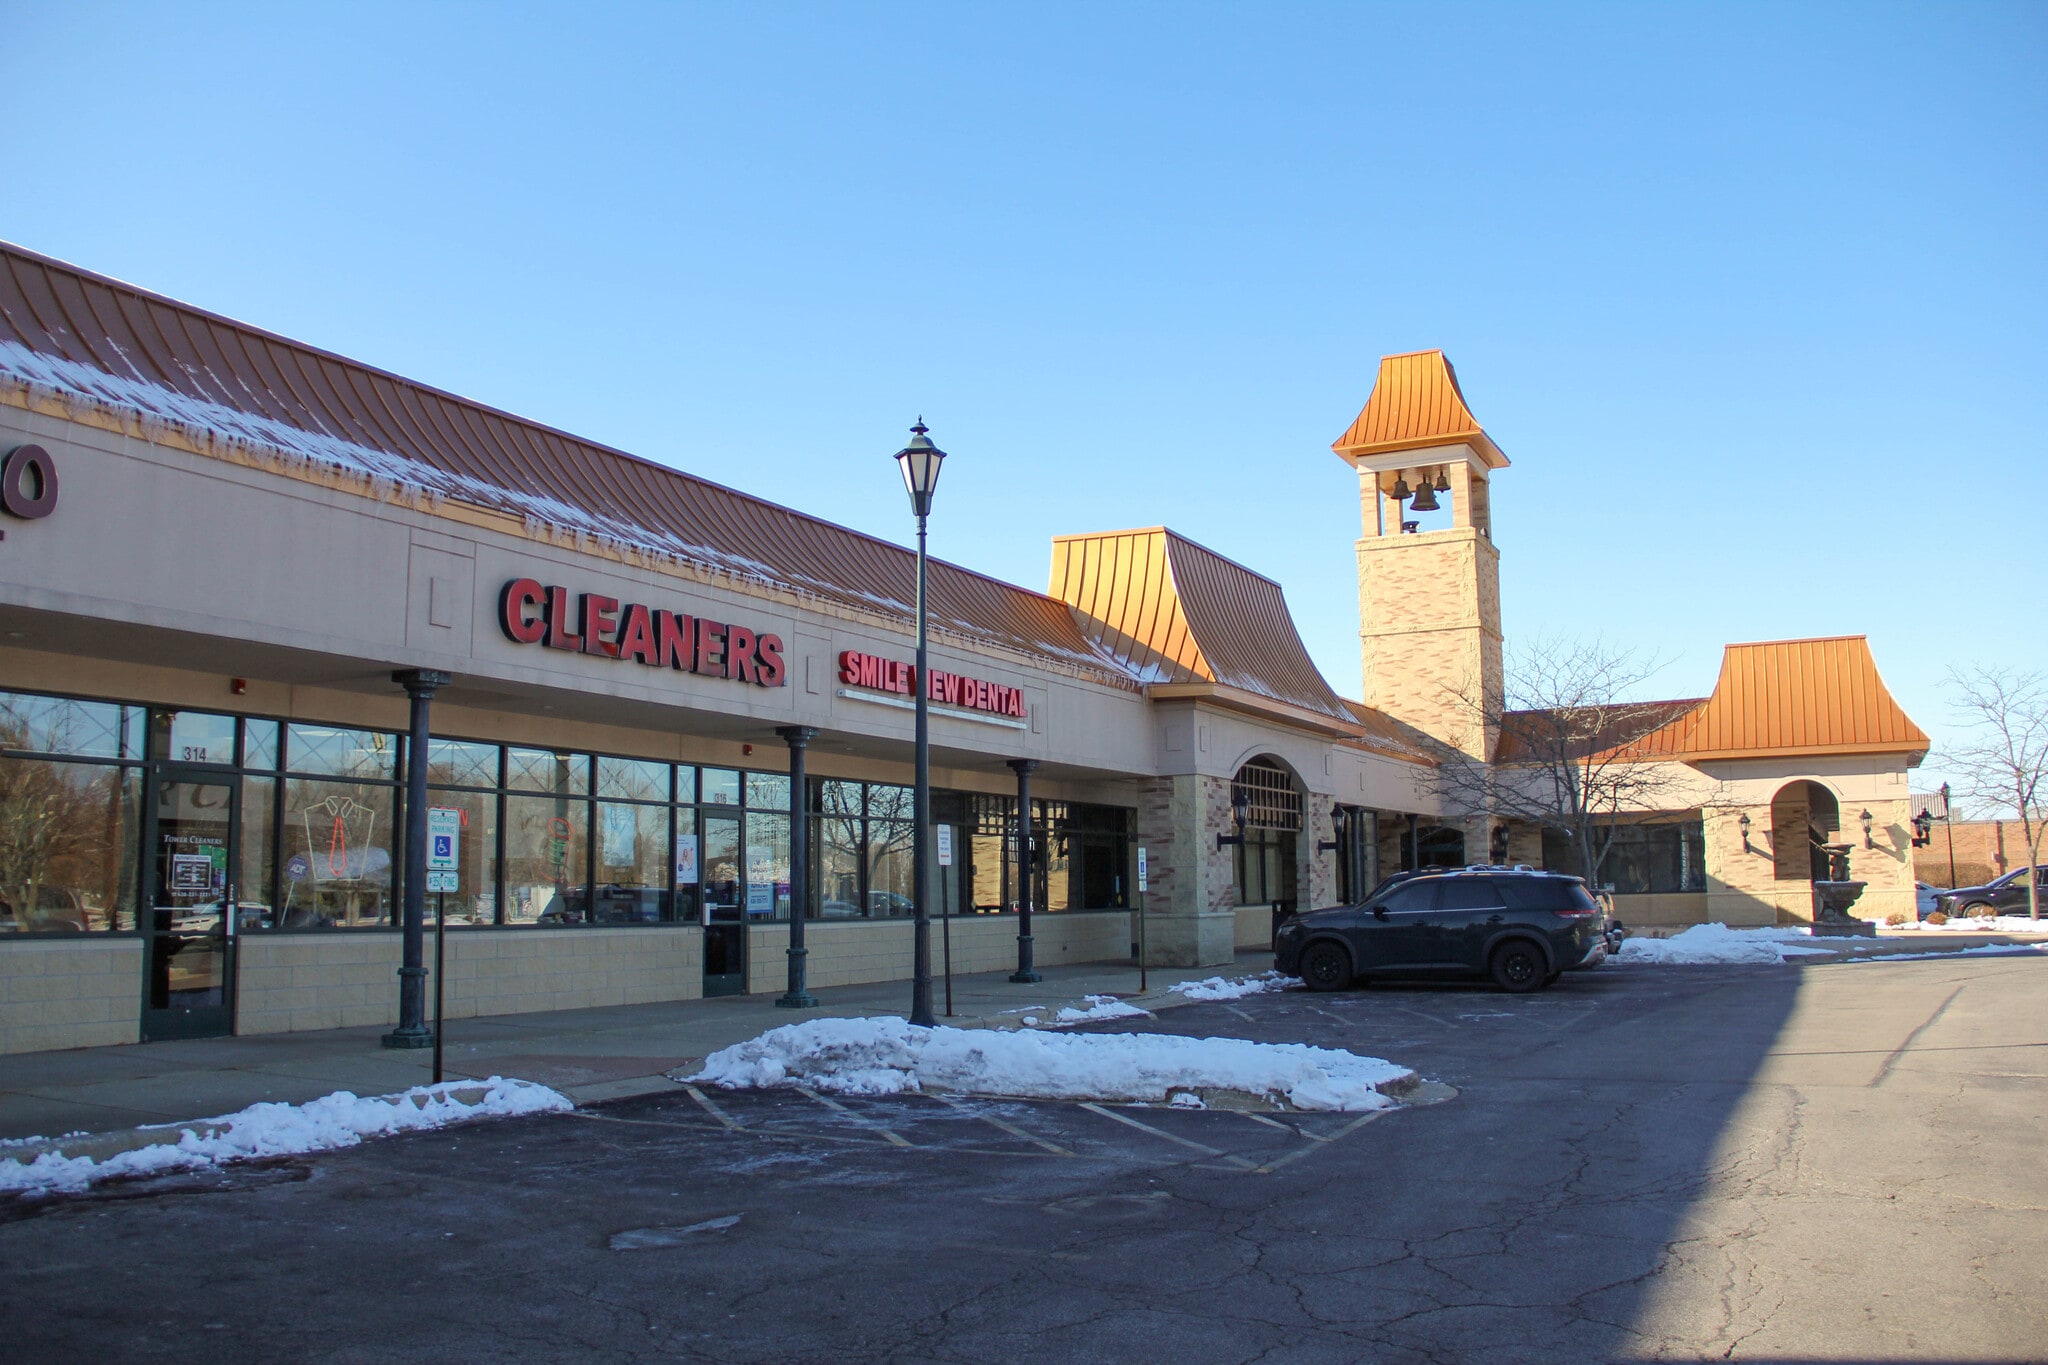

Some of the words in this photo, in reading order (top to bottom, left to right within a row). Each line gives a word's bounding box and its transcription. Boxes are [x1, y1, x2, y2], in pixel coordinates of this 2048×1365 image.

[499, 578, 786, 687] CLEANERS
[839, 650, 908, 694] SMILE
[907, 664, 960, 703] IEW
[957, 676, 1028, 718] DENTAL
[184, 747, 206, 762] 314
[714, 792, 727, 804] 316
[430, 814, 456, 824] RESERVED
[431, 825, 455, 834] PARKING
[164, 834, 188, 843] TOWER
[190, 836, 223, 845] CLEANERS
[290, 864, 306, 874] ADT
[444, 876, 456, 887] FINE
